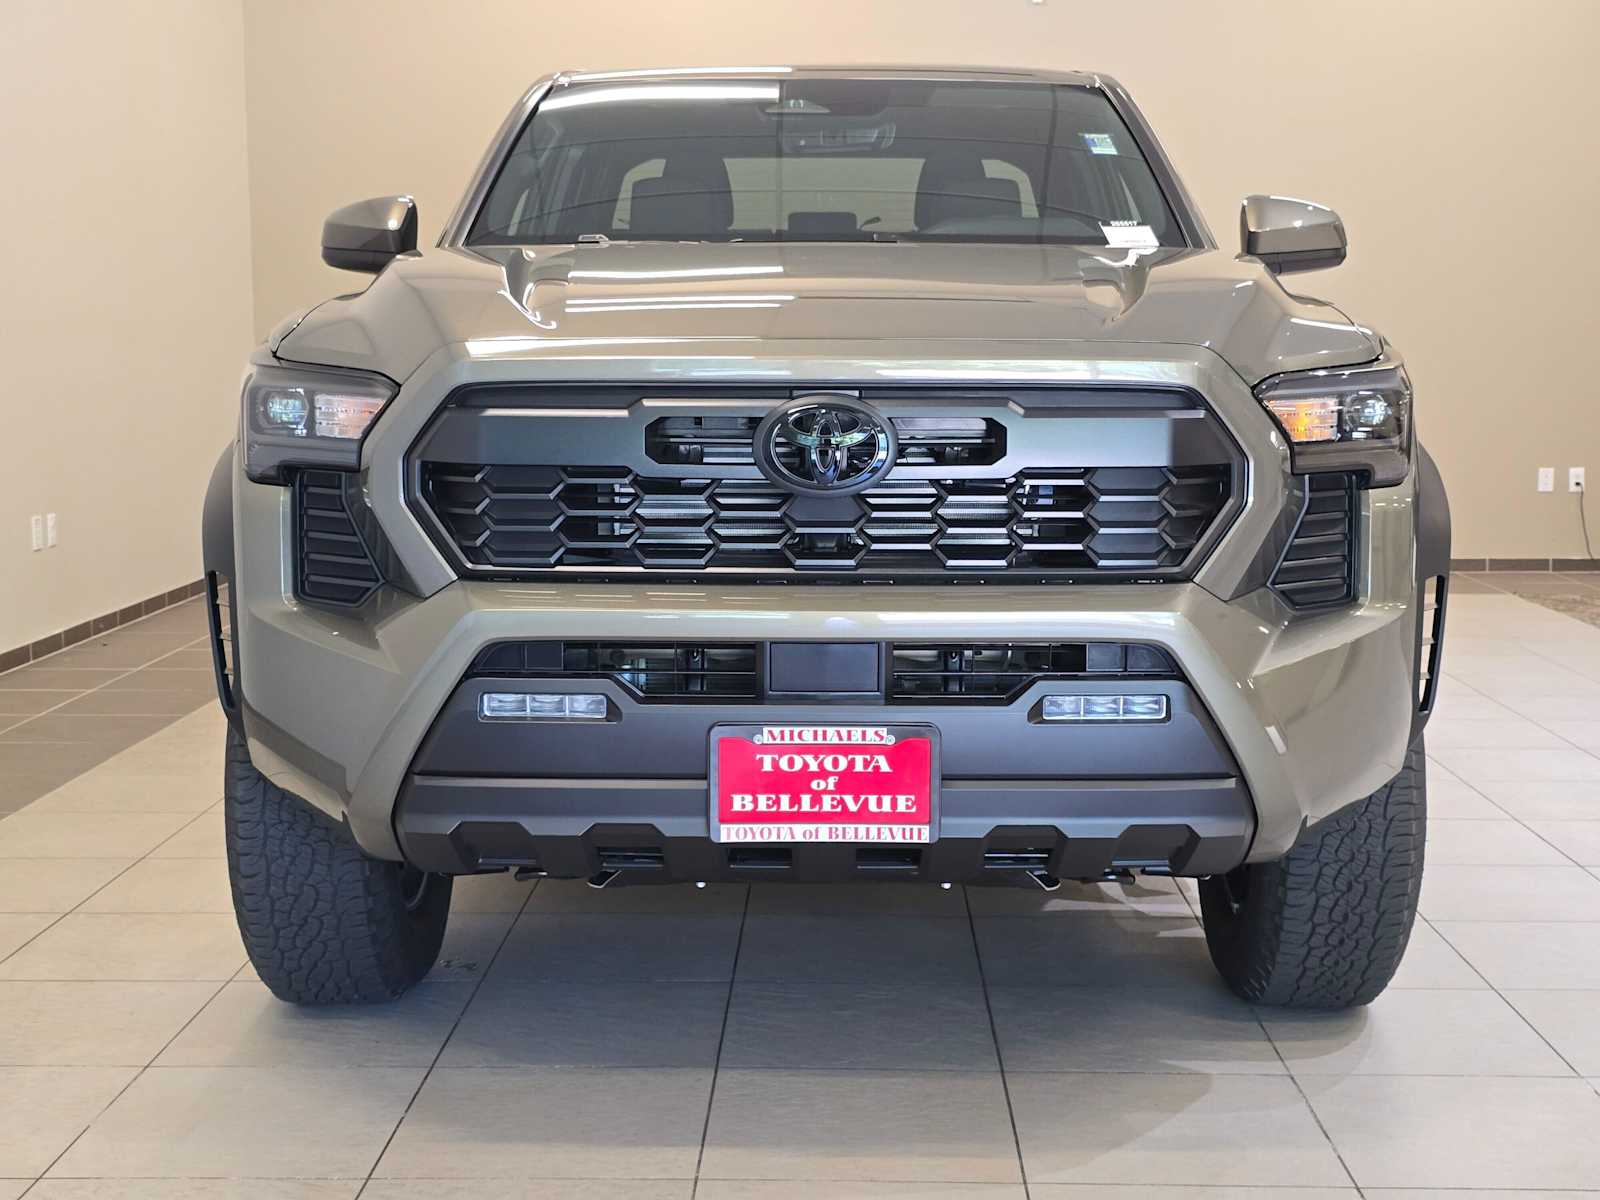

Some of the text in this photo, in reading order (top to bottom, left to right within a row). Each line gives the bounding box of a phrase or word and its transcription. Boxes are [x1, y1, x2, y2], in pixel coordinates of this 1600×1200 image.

[765, 729, 886, 742] MICHAELS
[756, 754, 892, 772] TOYOTA
[810, 776, 839, 790] of
[731, 794, 917, 812] BELLEVUE
[723, 827, 927, 841] TOYOTA of BELLEVUE
